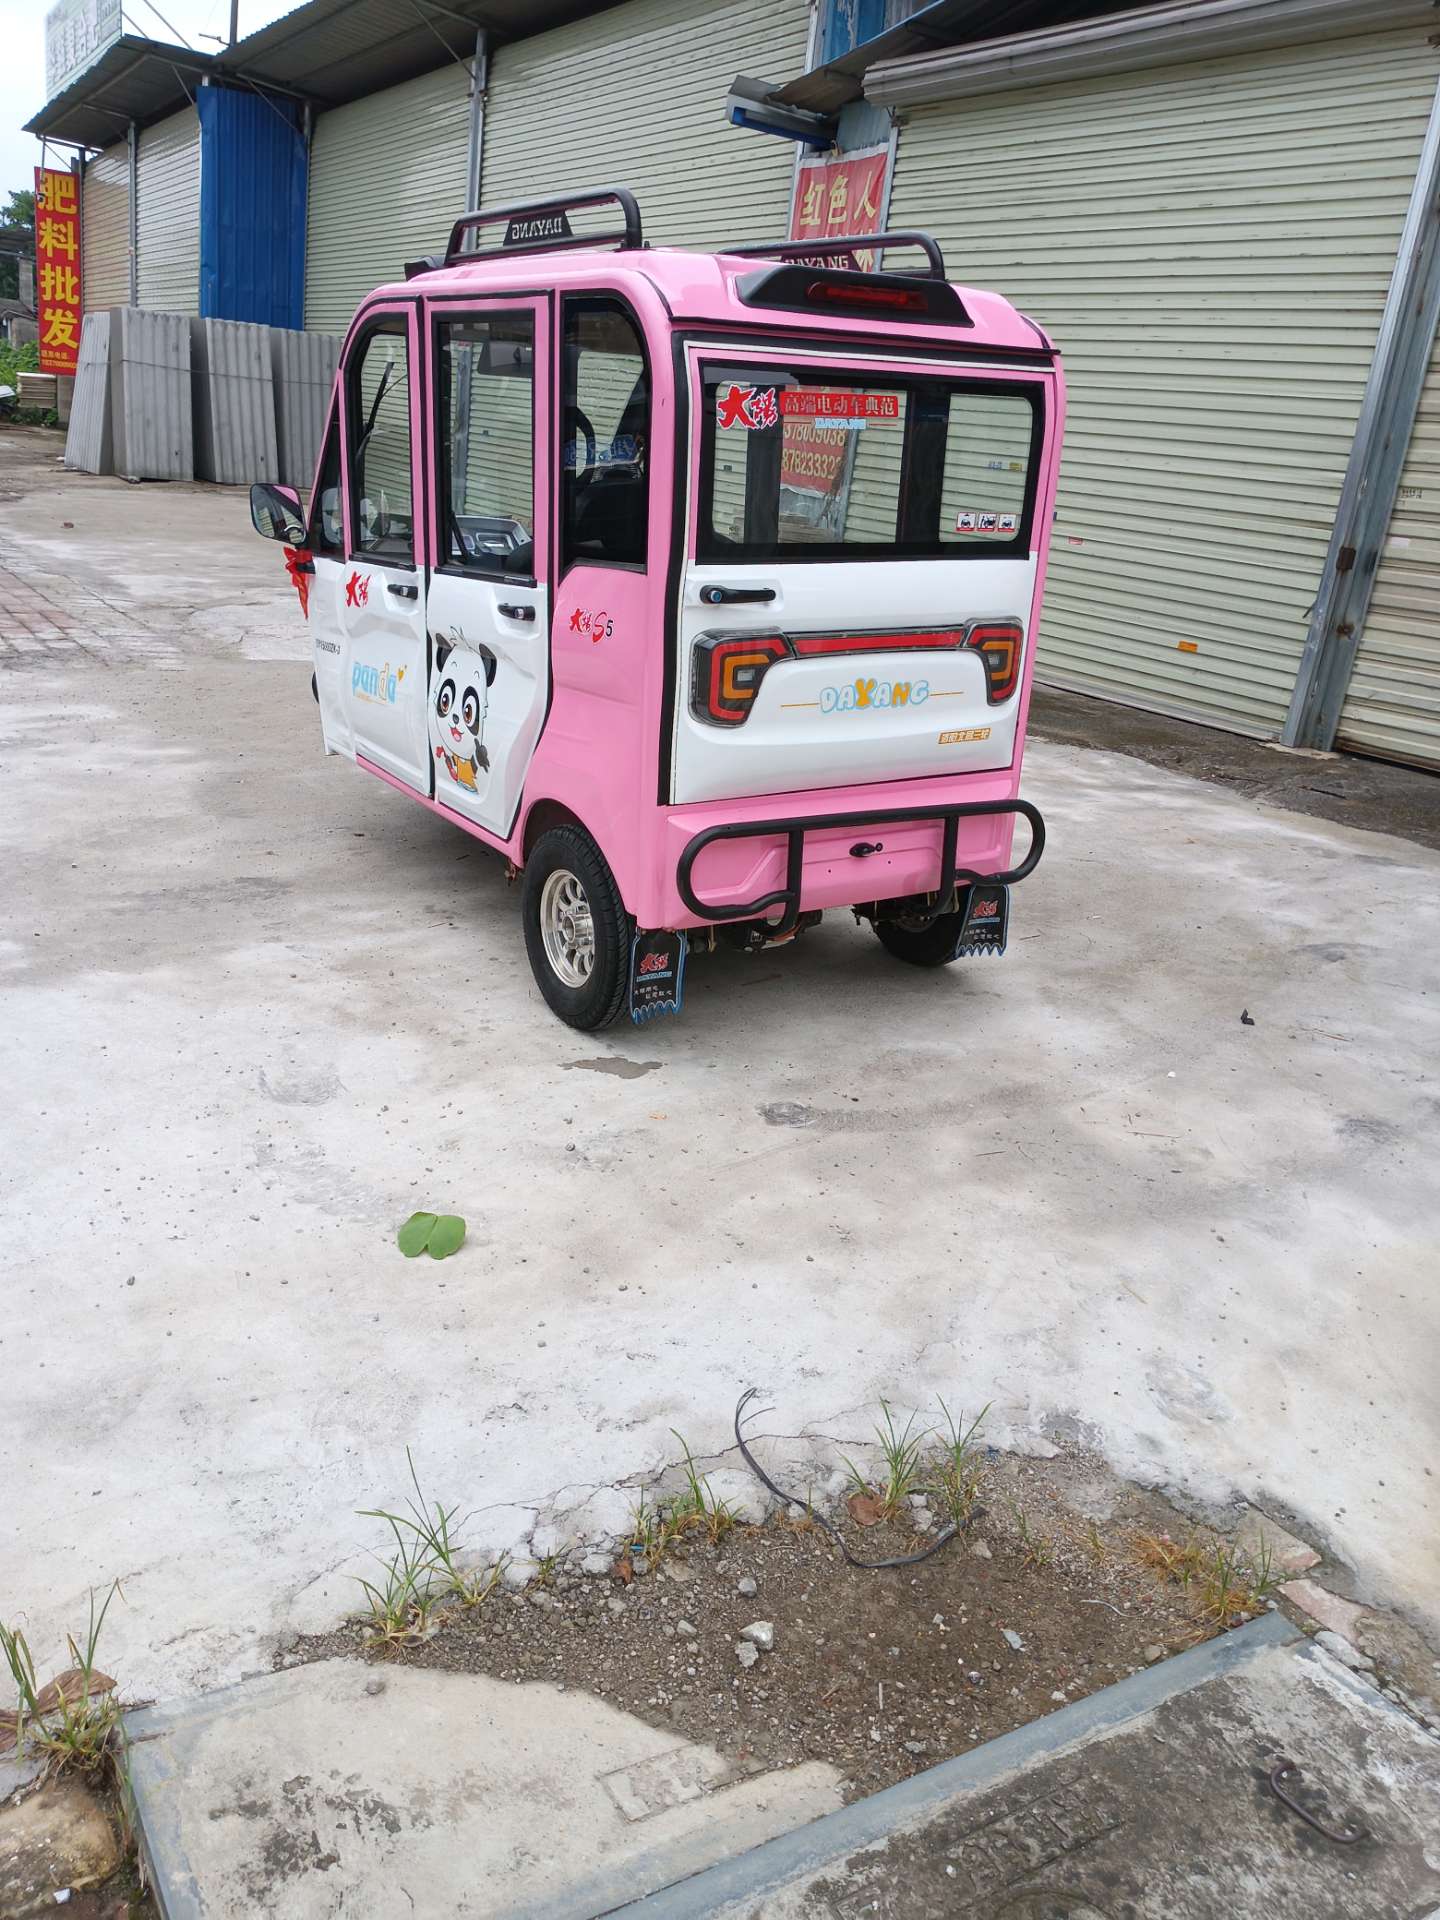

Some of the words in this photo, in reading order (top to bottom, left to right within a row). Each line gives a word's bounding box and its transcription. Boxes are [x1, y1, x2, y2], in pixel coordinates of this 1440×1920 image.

[800, 170, 876, 226] 红色人
[38, 173, 80, 349] 肥料批发
[784, 394, 895, 416] 高端电动车典范
[352, 661, 397, 705] panda
[819, 678, 930, 713] DAYANG
